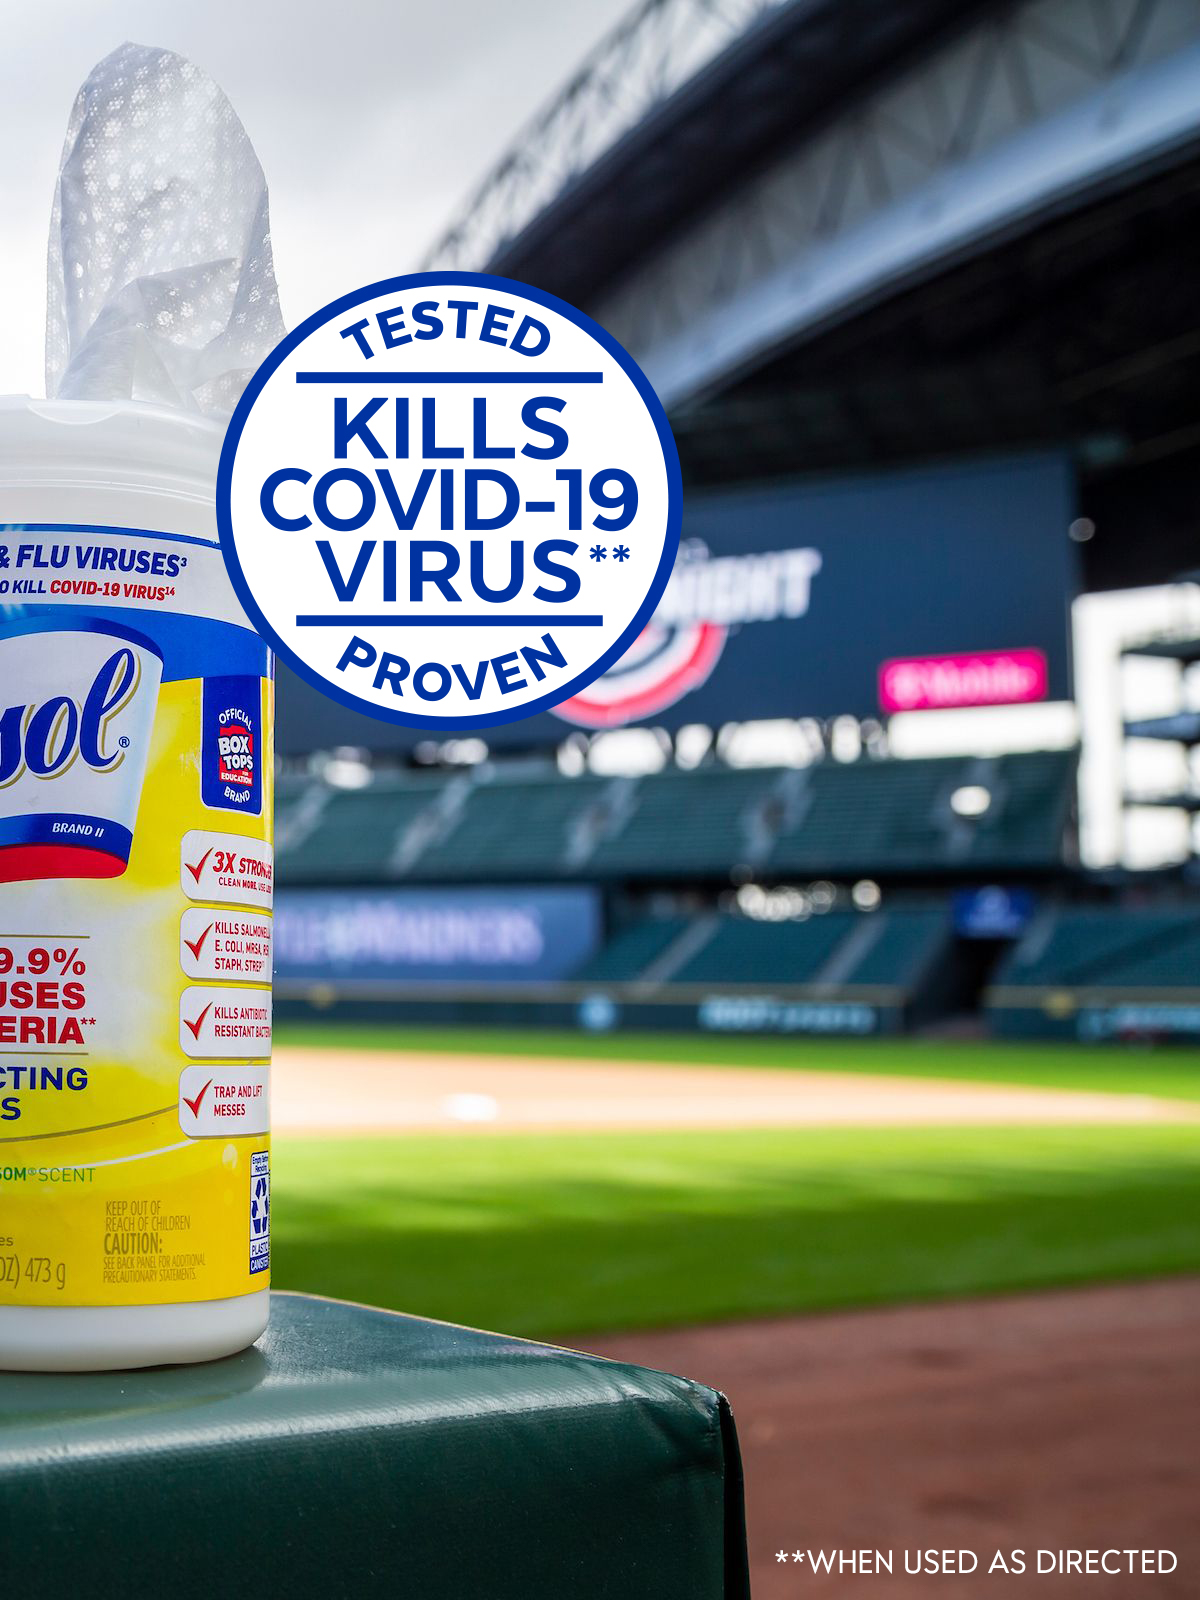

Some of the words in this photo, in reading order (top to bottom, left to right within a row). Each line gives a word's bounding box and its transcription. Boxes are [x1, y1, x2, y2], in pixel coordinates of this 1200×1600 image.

[16, 544, 70, 569] FLU
[12, 580, 47, 594] KILL
[50, 580, 120, 597] COVID-19
[219, 708, 252, 731] OFFICIAL
[218, 735, 250, 756] BOX
[223, 754, 253, 770] TOPS
[221, 772, 253, 785] EDUCATION
[224, 786, 250, 803] BRAND
[52, 822, 94, 837] BRAND
[94, 828, 105, 838] II
[212, 851, 237, 873] 3X
[218, 876, 240, 887] CLEAN
[215, 921, 239, 935] KILLS
[215, 940, 223, 951] E.
[225, 940, 244, 953] COLI,
[214, 957, 243, 972] STAPH,
[214, 1007, 239, 1019] KILLS
[214, 1025, 254, 1038] RESISTANT
[214, 1085, 236, 1098] TRAP
[238, 1085, 252, 1098] AND
[253, 1085, 263, 1097] LIFT
[214, 1104, 246, 1116] MESSES
[38, 1168, 97, 1183] SCENT
[106, 1201, 128, 1216] KEEP
[130, 1201, 148, 1216] OUT
[150, 1201, 161, 1216] OF
[106, 1217, 135, 1232] REACH
[137, 1217, 149, 1231] OF
[151, 1216, 191, 1231] CHILDREN
[104, 1232, 162, 1255] CAUTION:
[103, 1257, 115, 1270] SEE
[117, 1257, 134, 1270] BACK
[136, 1256, 157, 1269] PANEL
[159, 1255, 171, 1268] FOR
[25, 1257, 52, 1283] 473
[56, 1263, 66, 1290] g
[103, 1270, 158, 1284] PRECAUTIONARY
